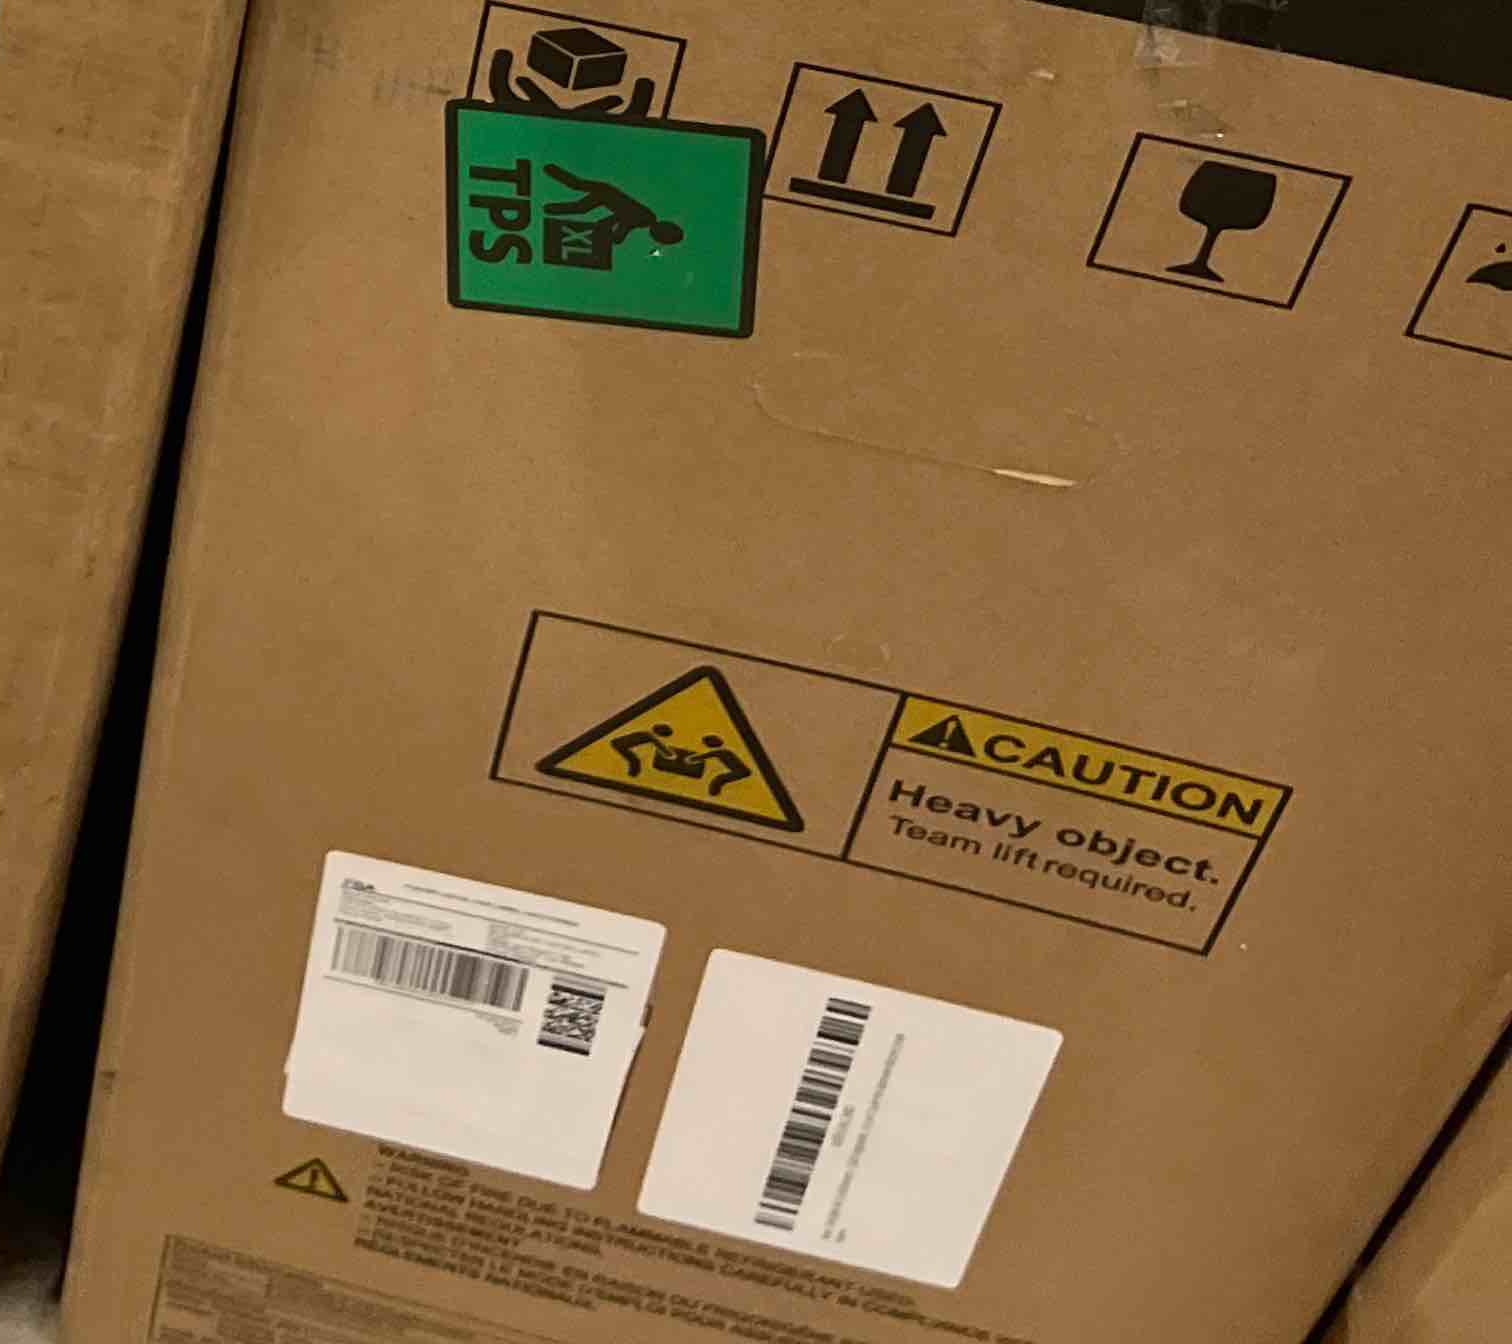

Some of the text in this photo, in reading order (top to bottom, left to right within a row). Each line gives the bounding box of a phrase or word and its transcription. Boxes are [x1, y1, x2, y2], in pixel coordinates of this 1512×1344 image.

[466, 158, 533, 267] TPS
[982, 732, 1266, 829] CAUTION
[888, 779, 1223, 886] Heavy object.
[889, 814, 1199, 913] Team lift required.
